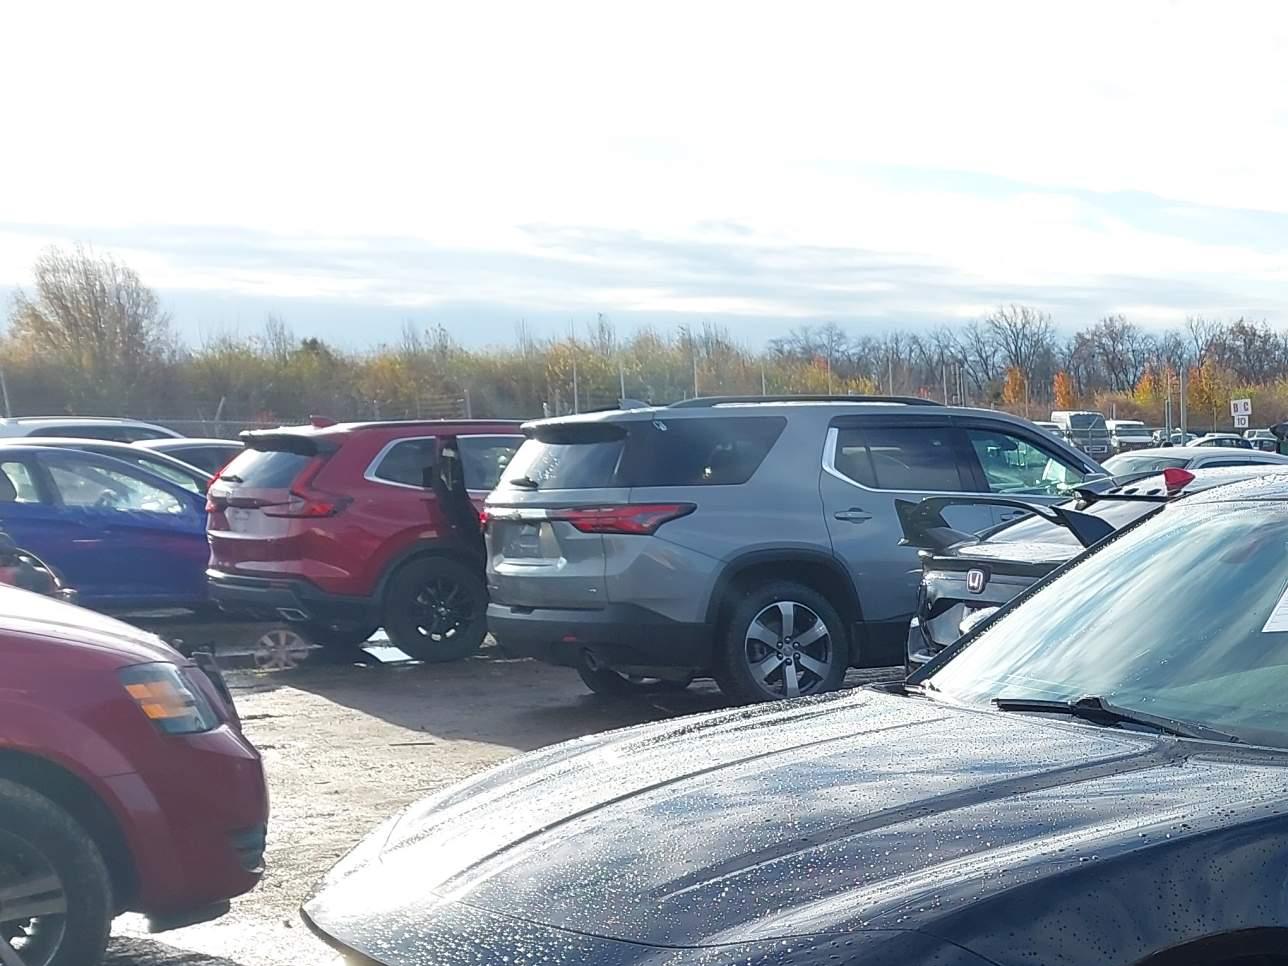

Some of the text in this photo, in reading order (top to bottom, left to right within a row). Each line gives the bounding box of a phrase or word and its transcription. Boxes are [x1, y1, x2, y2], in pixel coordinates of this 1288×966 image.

[1233, 401, 1249, 413] B C
[1236, 417, 1246, 426] 10
